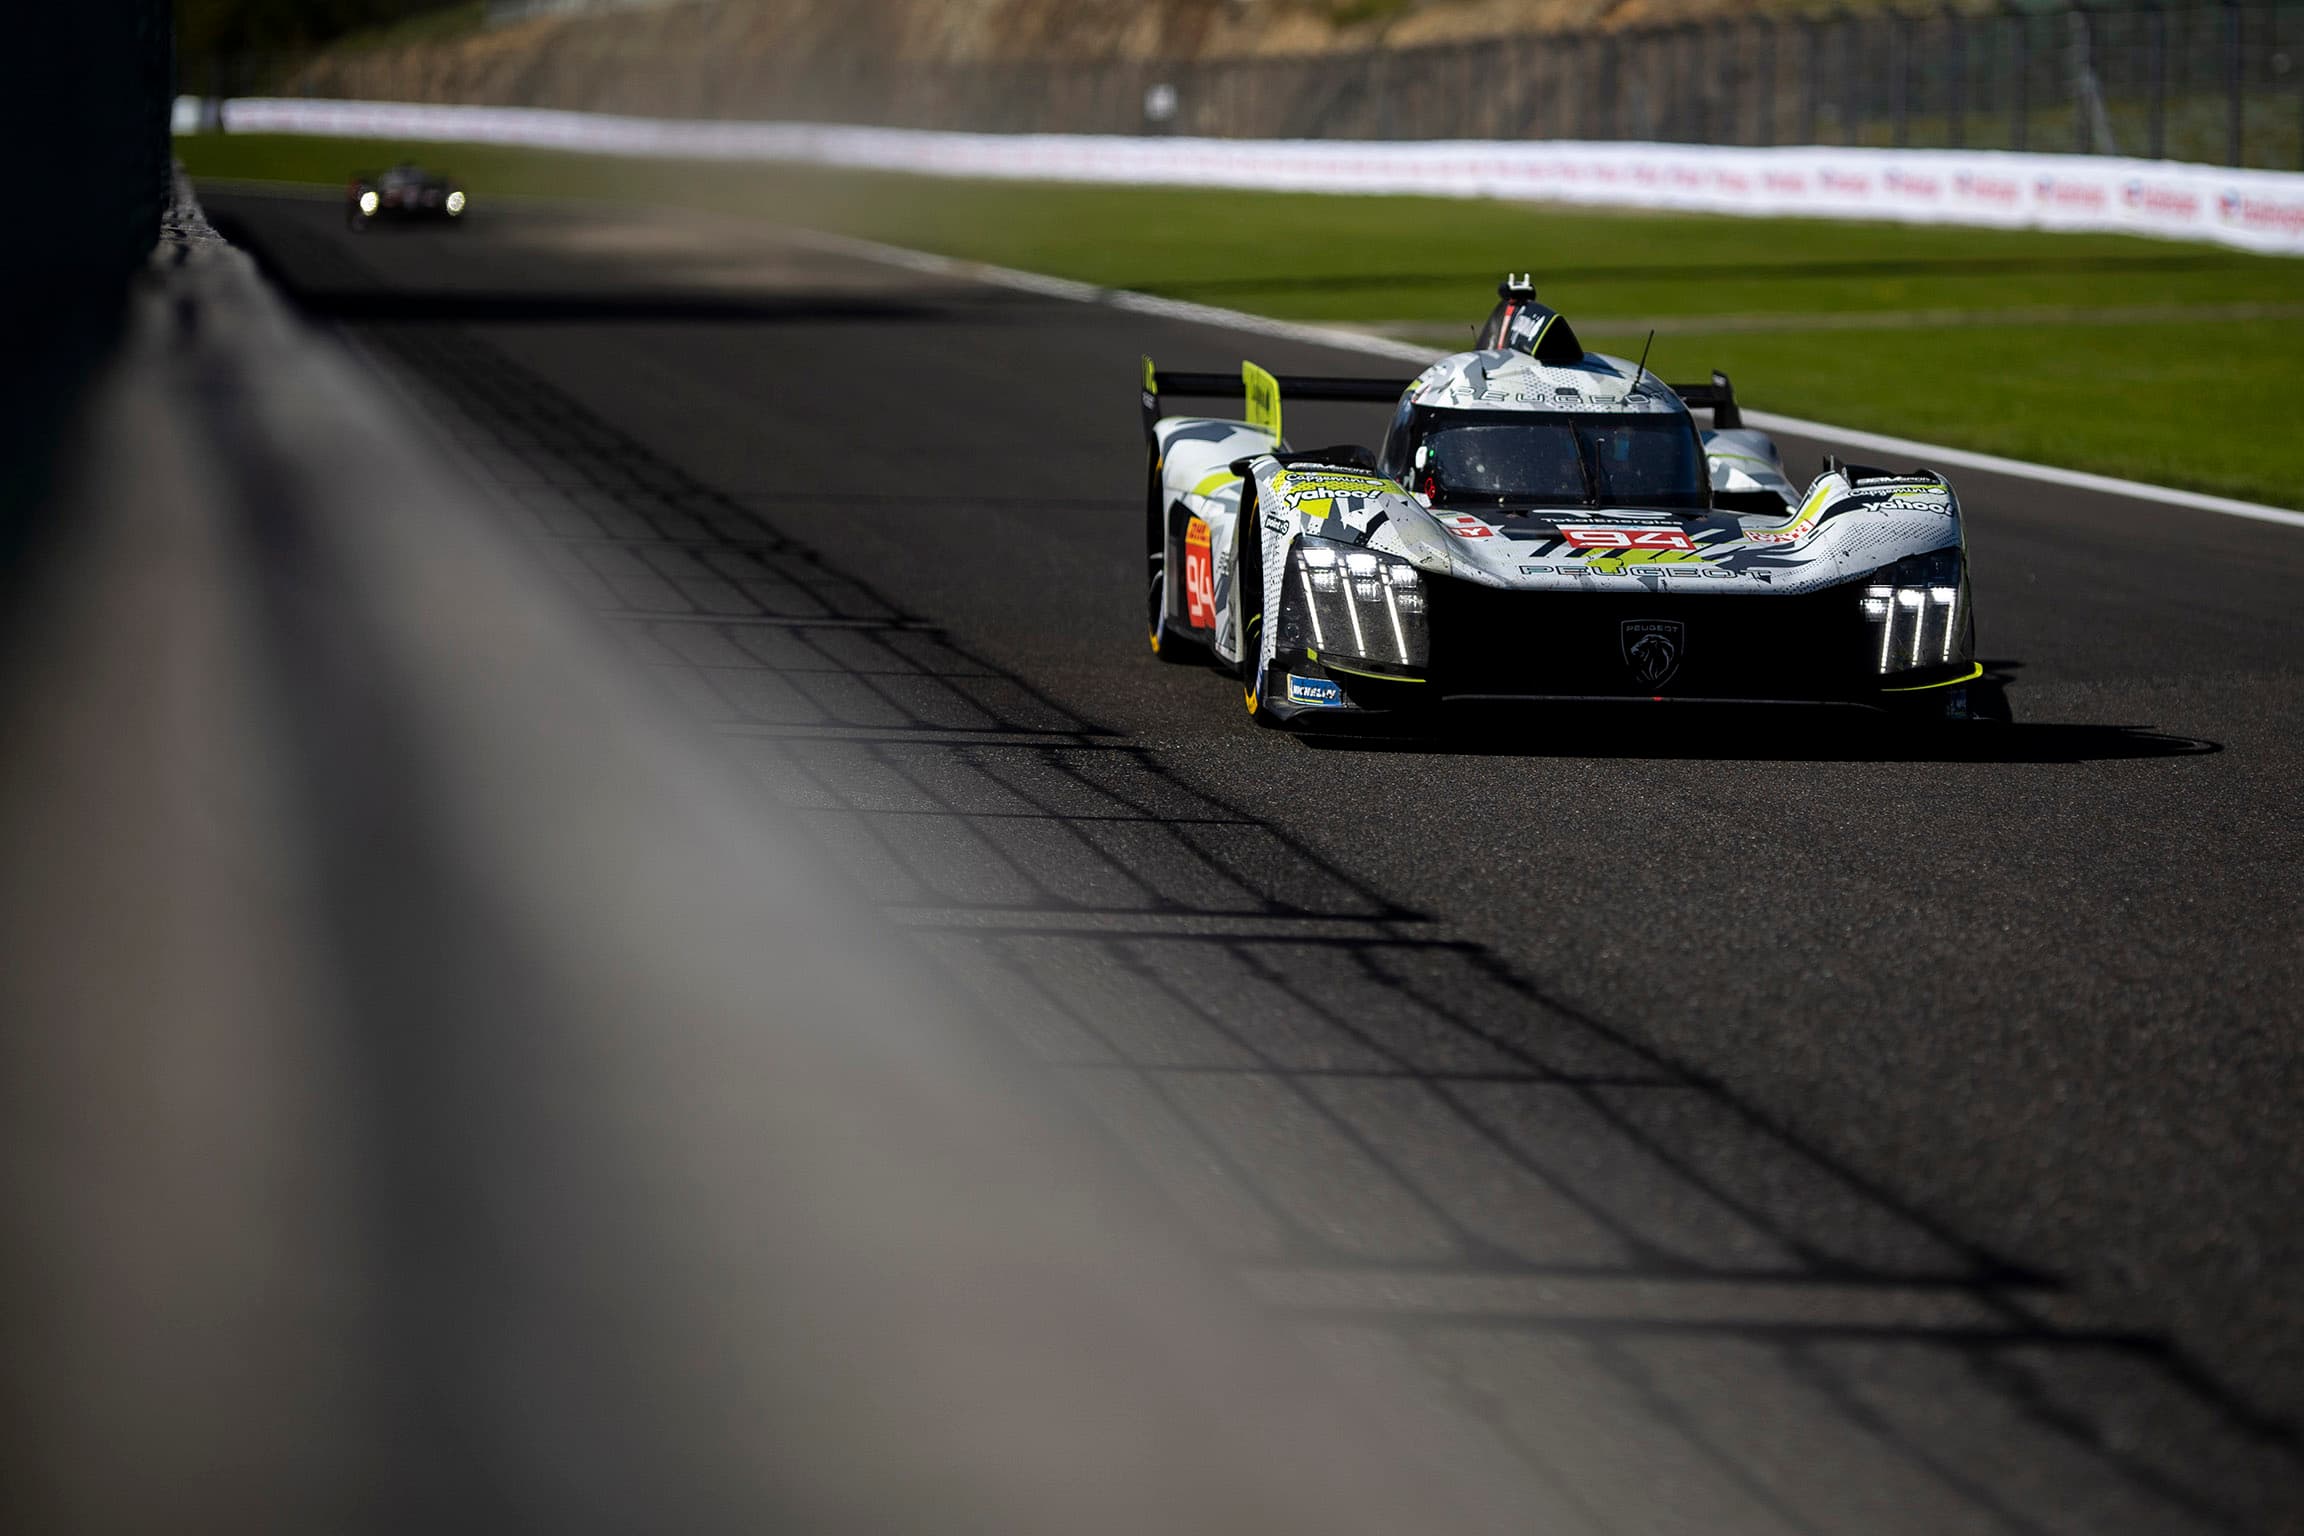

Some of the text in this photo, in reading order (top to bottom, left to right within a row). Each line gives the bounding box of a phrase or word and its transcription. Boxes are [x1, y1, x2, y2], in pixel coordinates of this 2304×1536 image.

[1286, 474, 1366, 484] Capgemini
[1285, 488, 1382, 510] yahoo!
[1862, 500, 1953, 516] yahoo!
[1541, 518, 1684, 526] TotalEnergies
[1569, 531, 1689, 548] 94
[1519, 565, 1772, 580] PEUGEOT
[1186, 555, 1216, 617] 94
[1626, 625, 1678, 633] PEUGEOT
